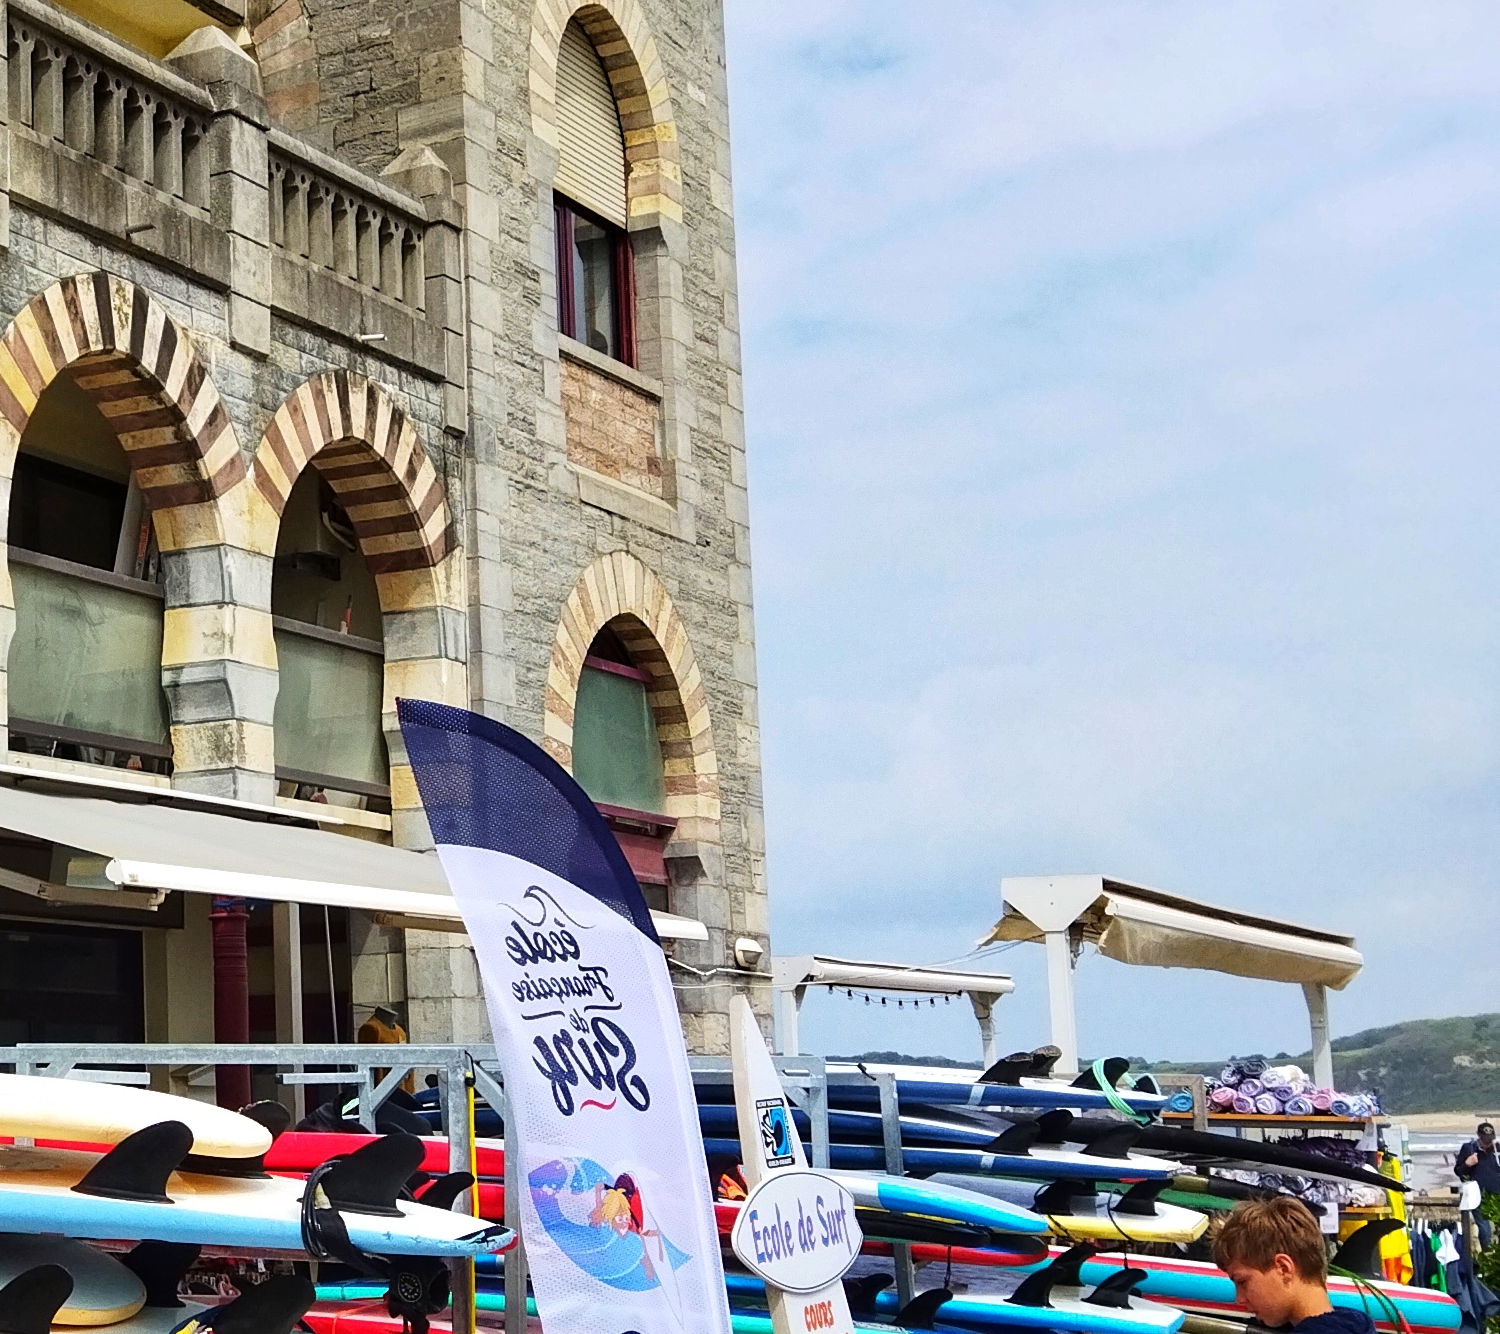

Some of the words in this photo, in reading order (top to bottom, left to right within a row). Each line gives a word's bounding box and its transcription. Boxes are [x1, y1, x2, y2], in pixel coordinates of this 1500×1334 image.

[749, 1202, 794, 1265] Ecole
[798, 1198, 816, 1254] de
[816, 1188, 852, 1256] Surf
[804, 1300, 835, 1333] COURS
